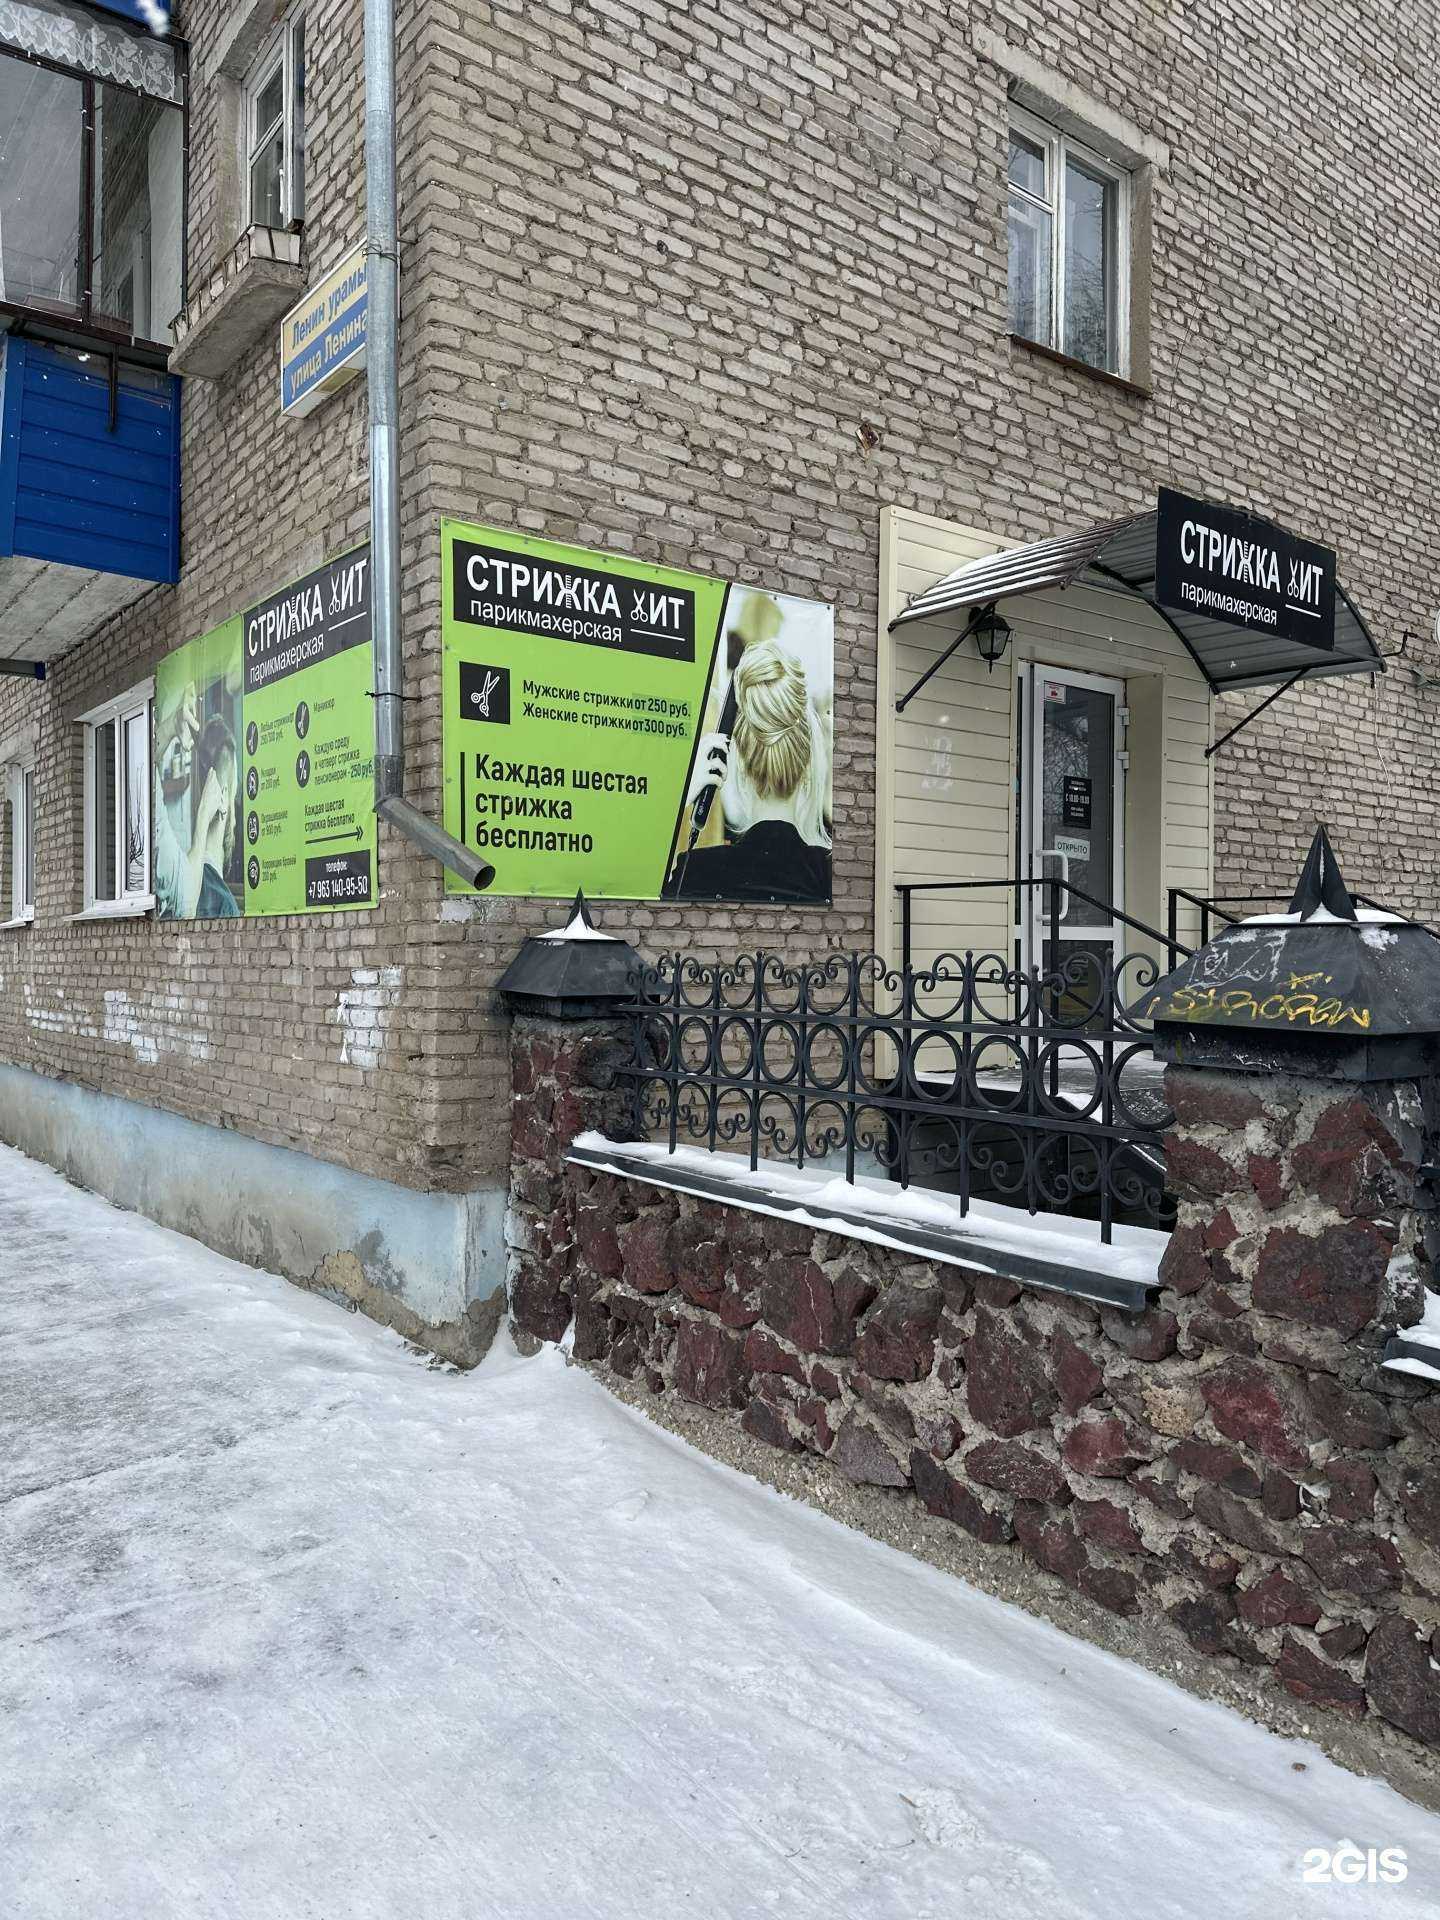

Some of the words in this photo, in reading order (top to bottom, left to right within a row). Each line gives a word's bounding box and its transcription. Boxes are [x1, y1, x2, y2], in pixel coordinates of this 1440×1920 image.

[291, 302, 325, 349] Ленин
[328, 262, 367, 322] урамы
[291, 350, 322, 400] улица
[324, 308, 368, 363] Ленина
[1180, 520, 1281, 593] СТРИЖКА
[466, 555, 622, 619] СТРИЖКА
[1181, 582, 1277, 626] парикмахерская
[248, 584, 324, 657] СТРИЖКА
[470, 599, 622, 643] парикмахерская
[250, 633, 324, 684] парикмахерская
[523, 680, 580, 701] Мужские
[583, 691, 633, 709] стрижки
[634, 700, 646, 710] от
[648, 698, 667, 713] 250
[669, 703, 691, 718] руб.
[523, 702, 578, 723] Женские
[581, 712, 632, 729] стрижки
[632, 721, 644, 732] от
[644, 719, 664, 734] 300
[665, 723, 688, 738] руб.
[314, 740, 334, 755] Каждую
[334, 735, 350, 751] среду
[319, 755, 337, 769] четверг
[338, 749, 360, 765] стрижка
[361, 759, 375, 779] руб.
[475, 754, 565, 788] Каждая
[572, 770, 648, 795] шестая
[304, 802, 324, 818] Каждая
[325, 799, 345, 813] шестая
[304, 818, 326, 833] стрижка
[327, 812, 355, 828] бесплатно
[475, 792, 572, 820] стрижка
[475, 820, 593, 854] бесплатно
[1057, 842, 1088, 854] ОТКРЫТО
[308, 881, 316, 899] +7
[317, 879, 330, 899] 963
[331, 875, 368, 898] 140-95-50
